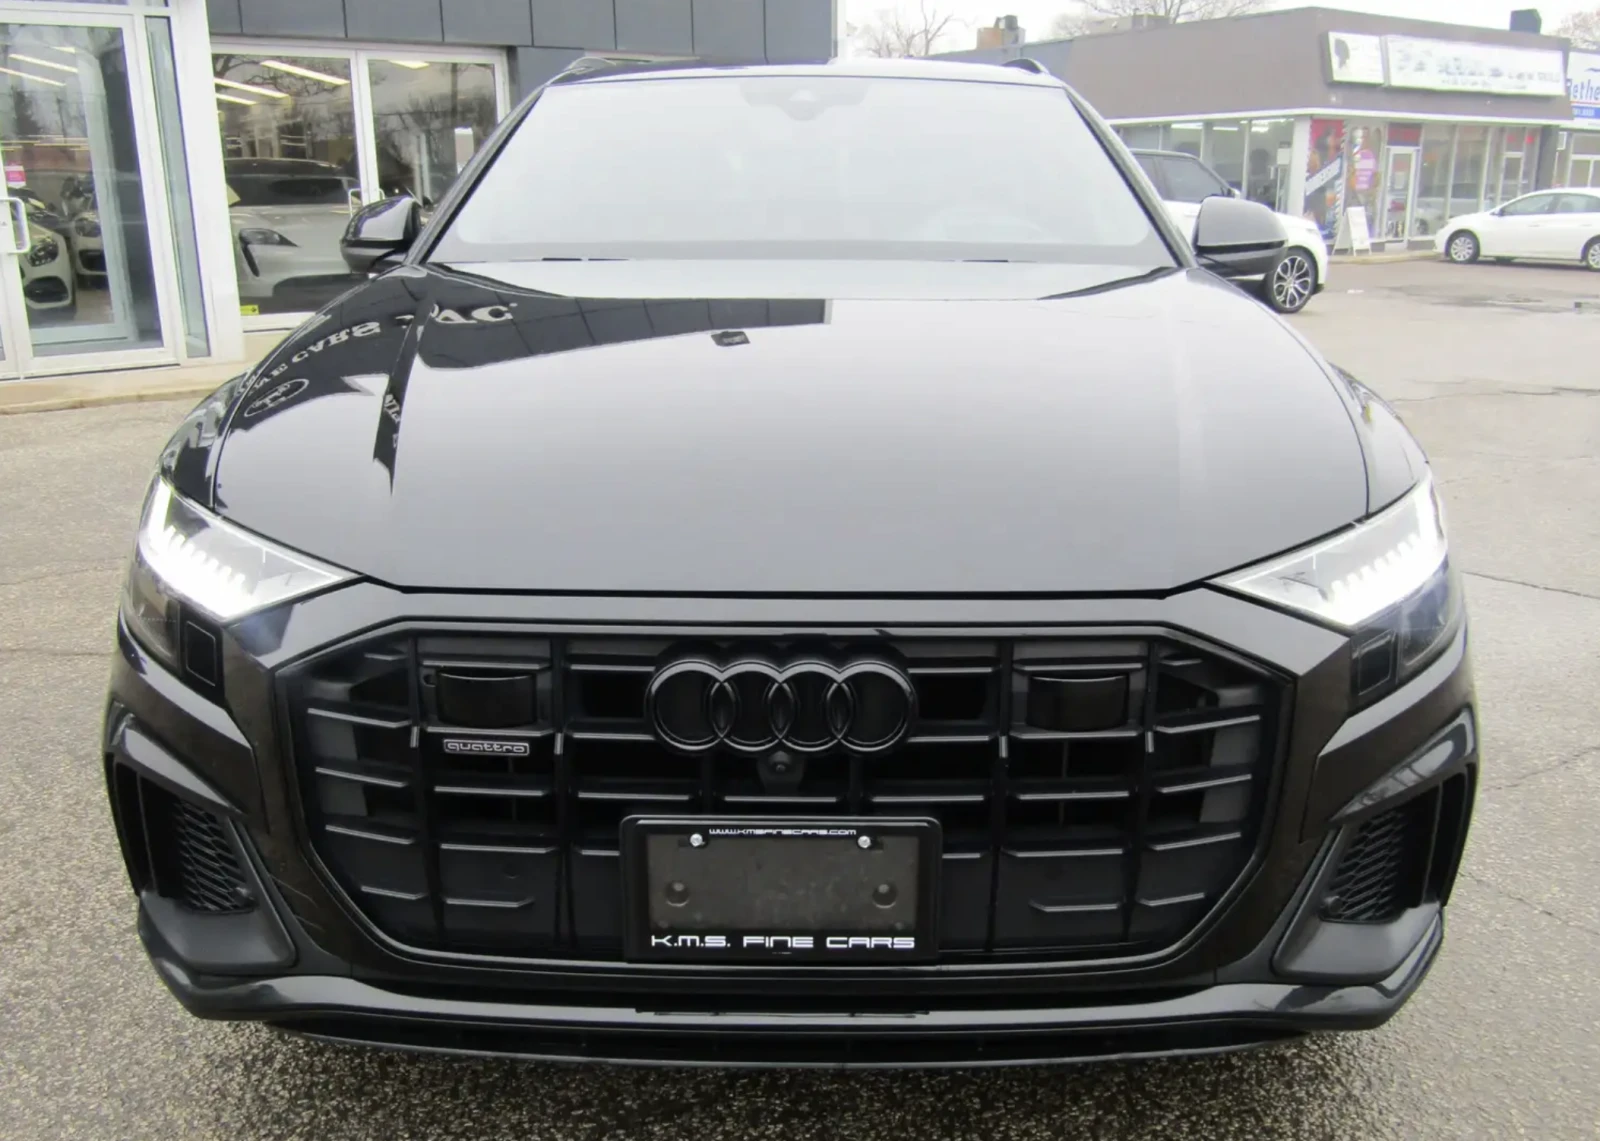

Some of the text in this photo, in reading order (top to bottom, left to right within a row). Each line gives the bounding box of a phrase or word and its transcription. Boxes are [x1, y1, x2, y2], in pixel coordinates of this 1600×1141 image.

[447, 742, 525, 753] quattro
[651, 935, 915, 949] K.M.S. FINE CARS
